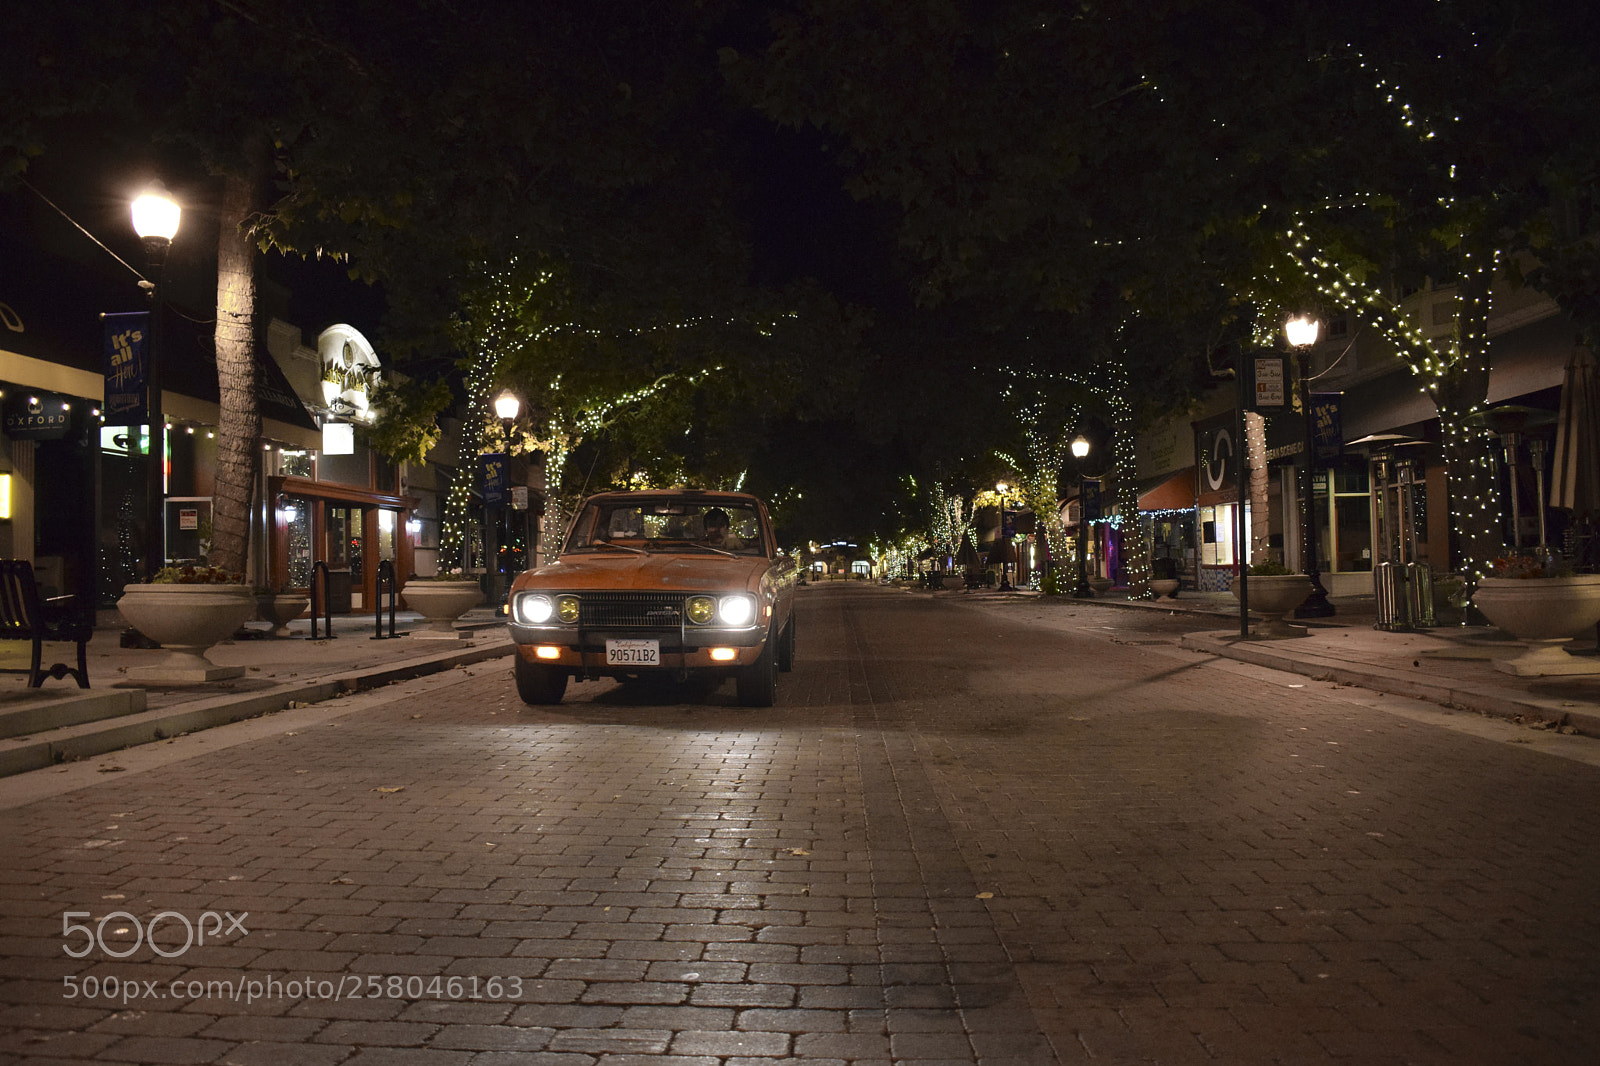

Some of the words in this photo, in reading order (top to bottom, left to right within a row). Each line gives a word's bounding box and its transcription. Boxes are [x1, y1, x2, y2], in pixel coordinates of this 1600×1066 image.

[111, 329, 142, 350] It's
[110, 345, 133, 366] all
[1315, 404, 1338, 417] It's
[7, 415, 65, 426] OXFORD
[1316, 414, 1332, 428] all
[610, 649, 656, 661] 90571B2
